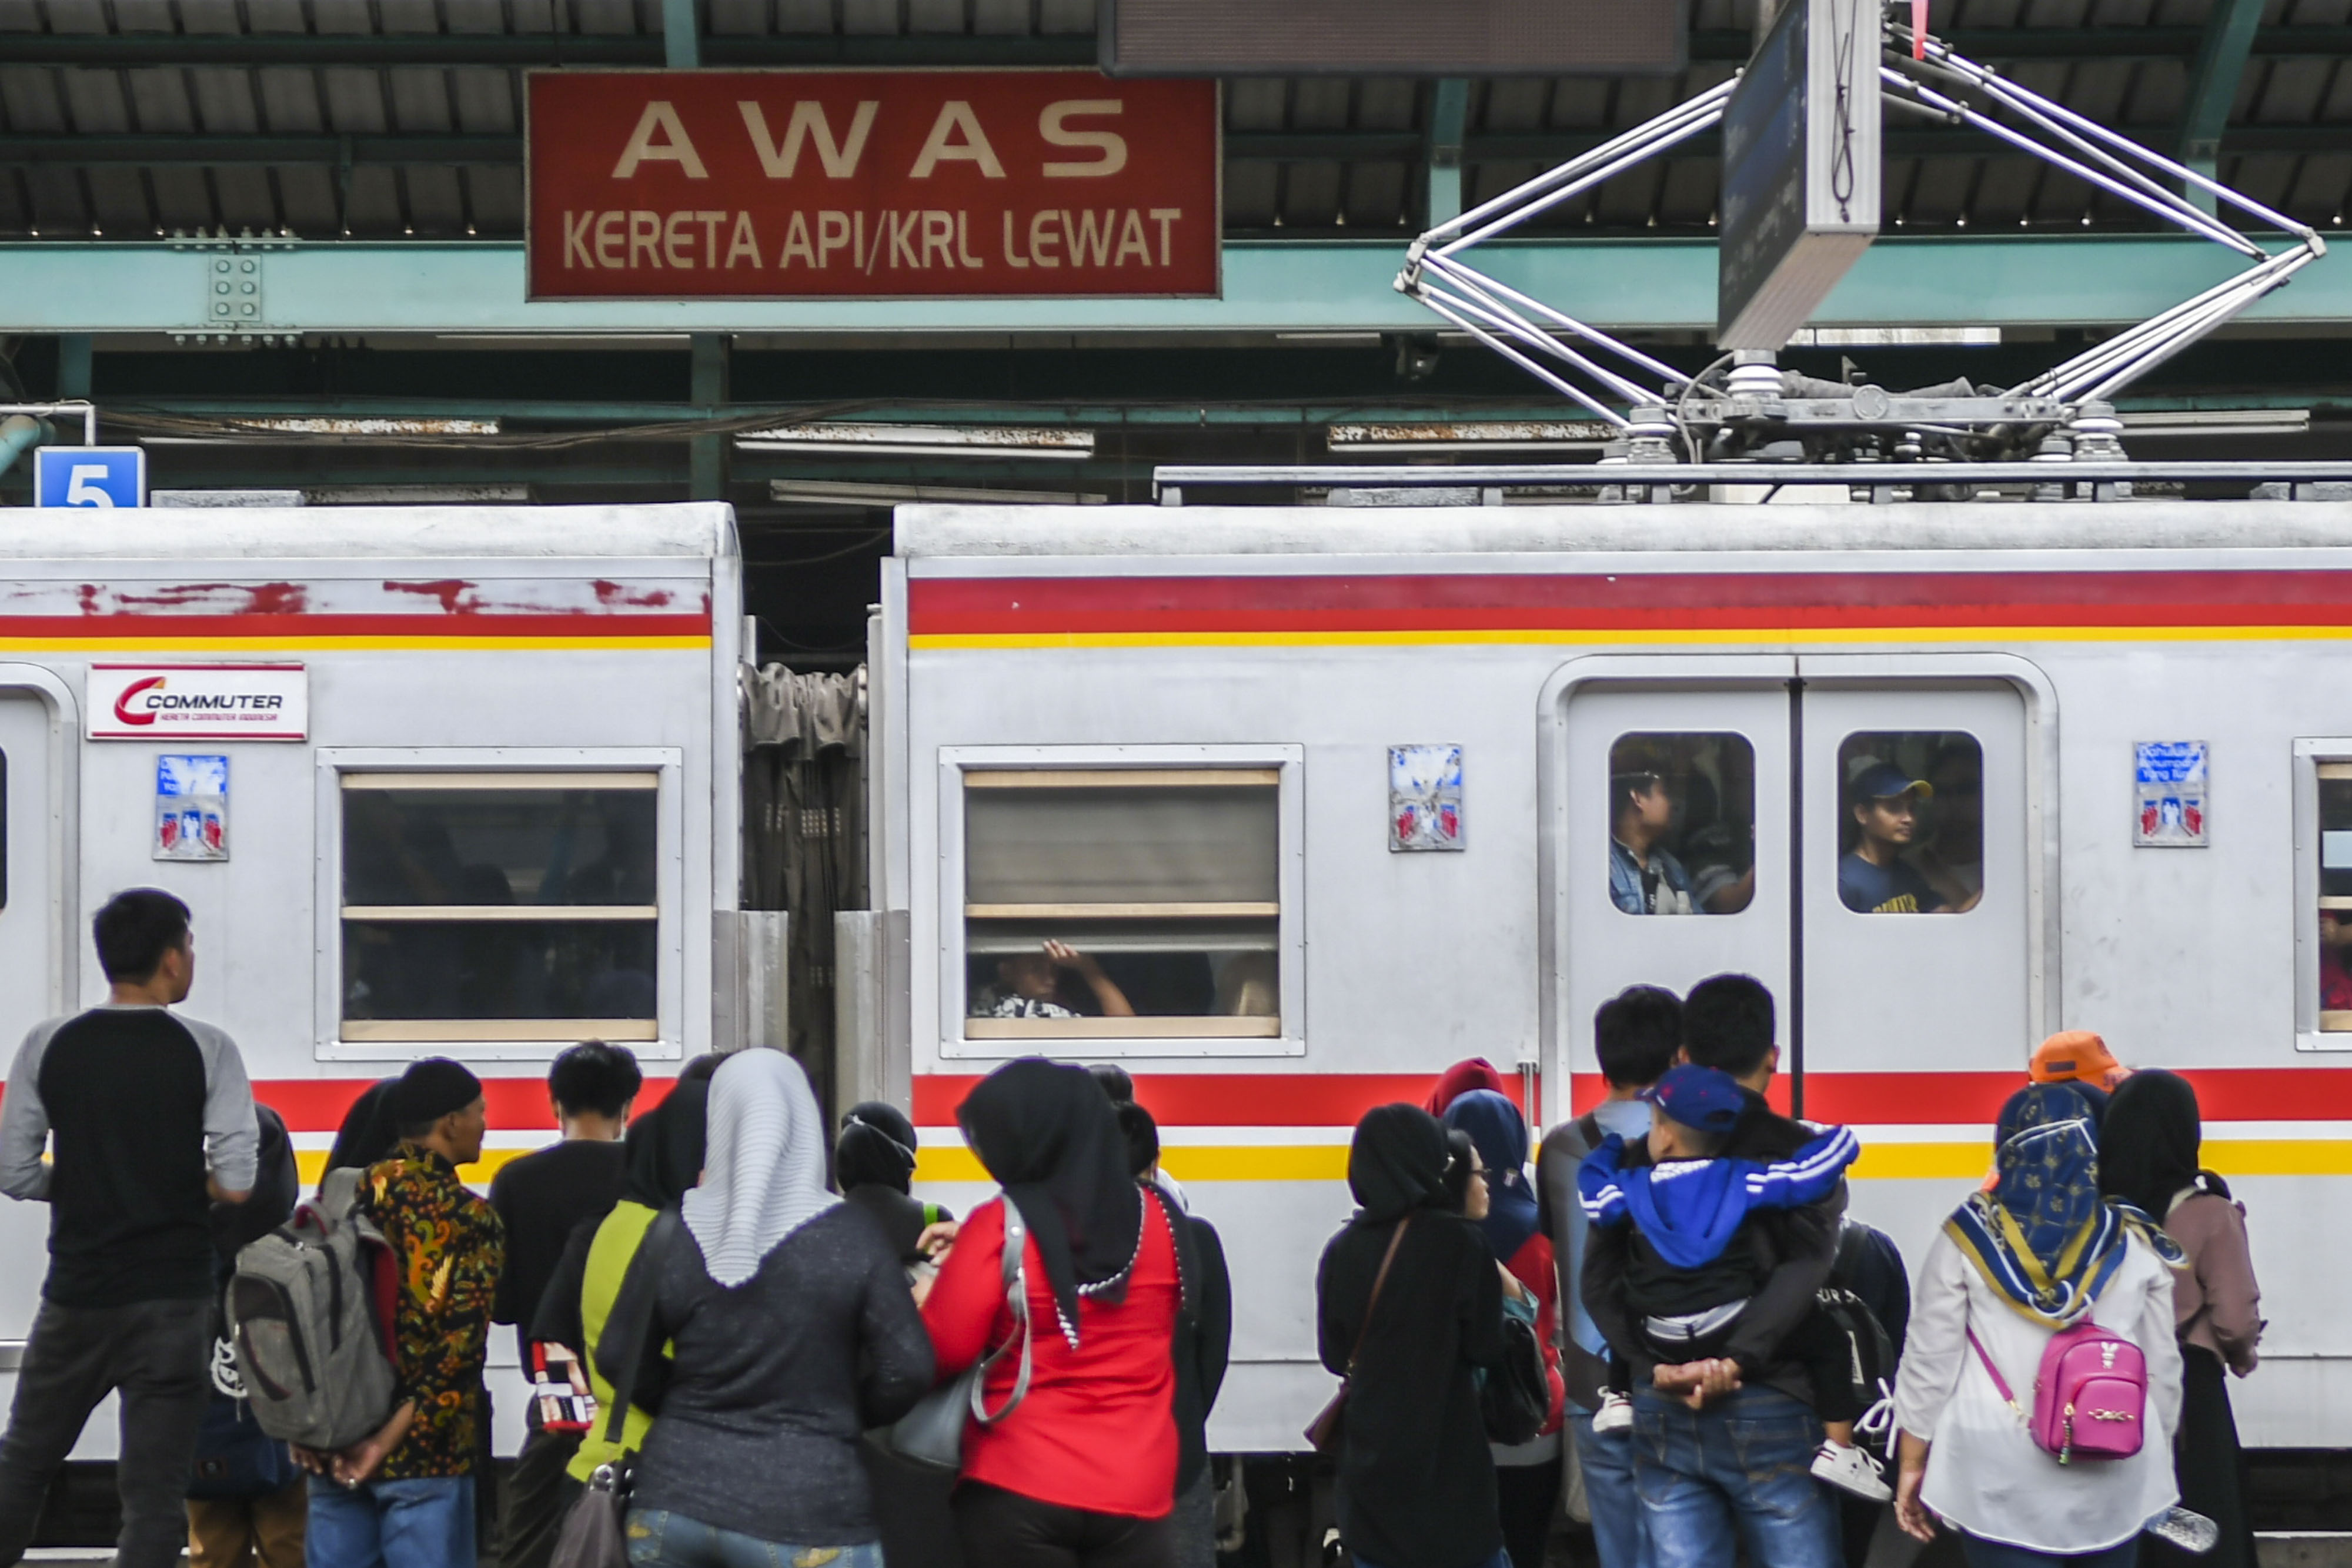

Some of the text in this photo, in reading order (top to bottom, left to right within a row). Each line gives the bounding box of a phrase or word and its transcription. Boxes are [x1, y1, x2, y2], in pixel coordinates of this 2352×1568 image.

[612, 99, 1128, 179] AWAS
[563, 208, 1182, 276] KERETA API/KRL LEWAT
[66, 464, 114, 507] 5
[146, 695, 282, 708] COMMUTER
